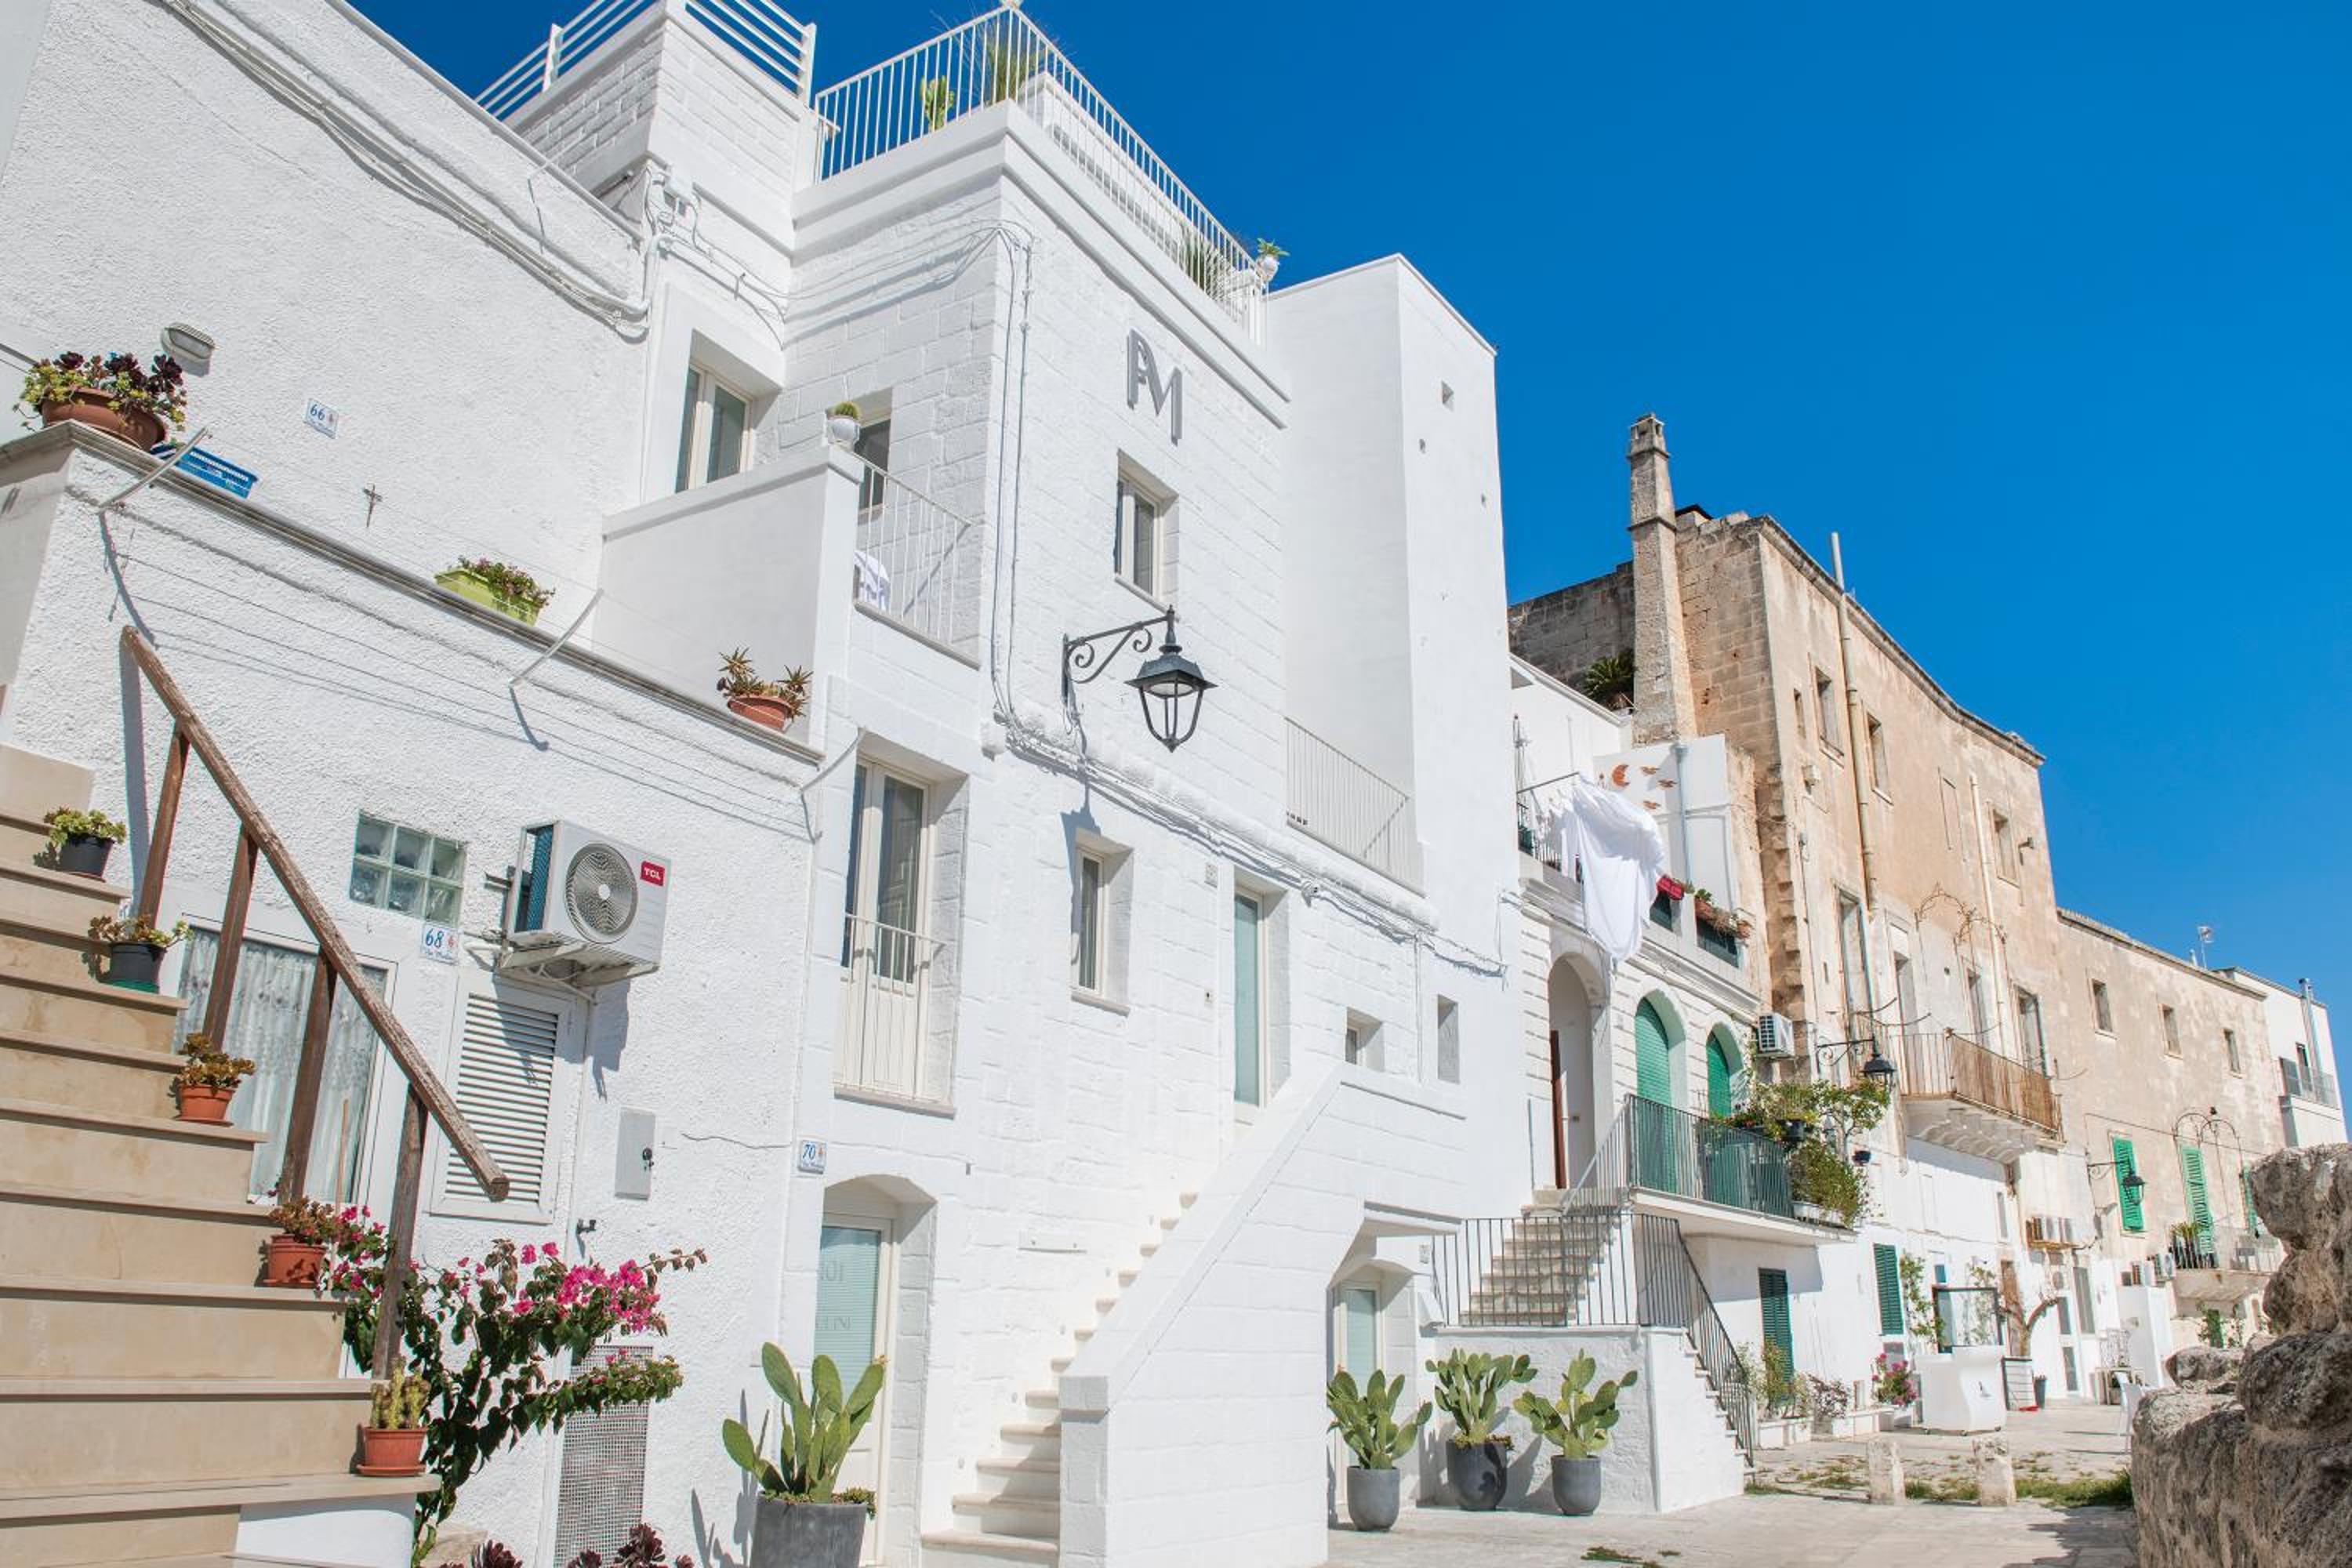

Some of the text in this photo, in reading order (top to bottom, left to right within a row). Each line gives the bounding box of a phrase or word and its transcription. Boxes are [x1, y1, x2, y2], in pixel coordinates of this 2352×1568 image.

[310, 404, 325, 421] 66
[644, 866, 661, 880] TCL
[426, 928, 444, 949] 68
[802, 1144, 816, 1160] 70
